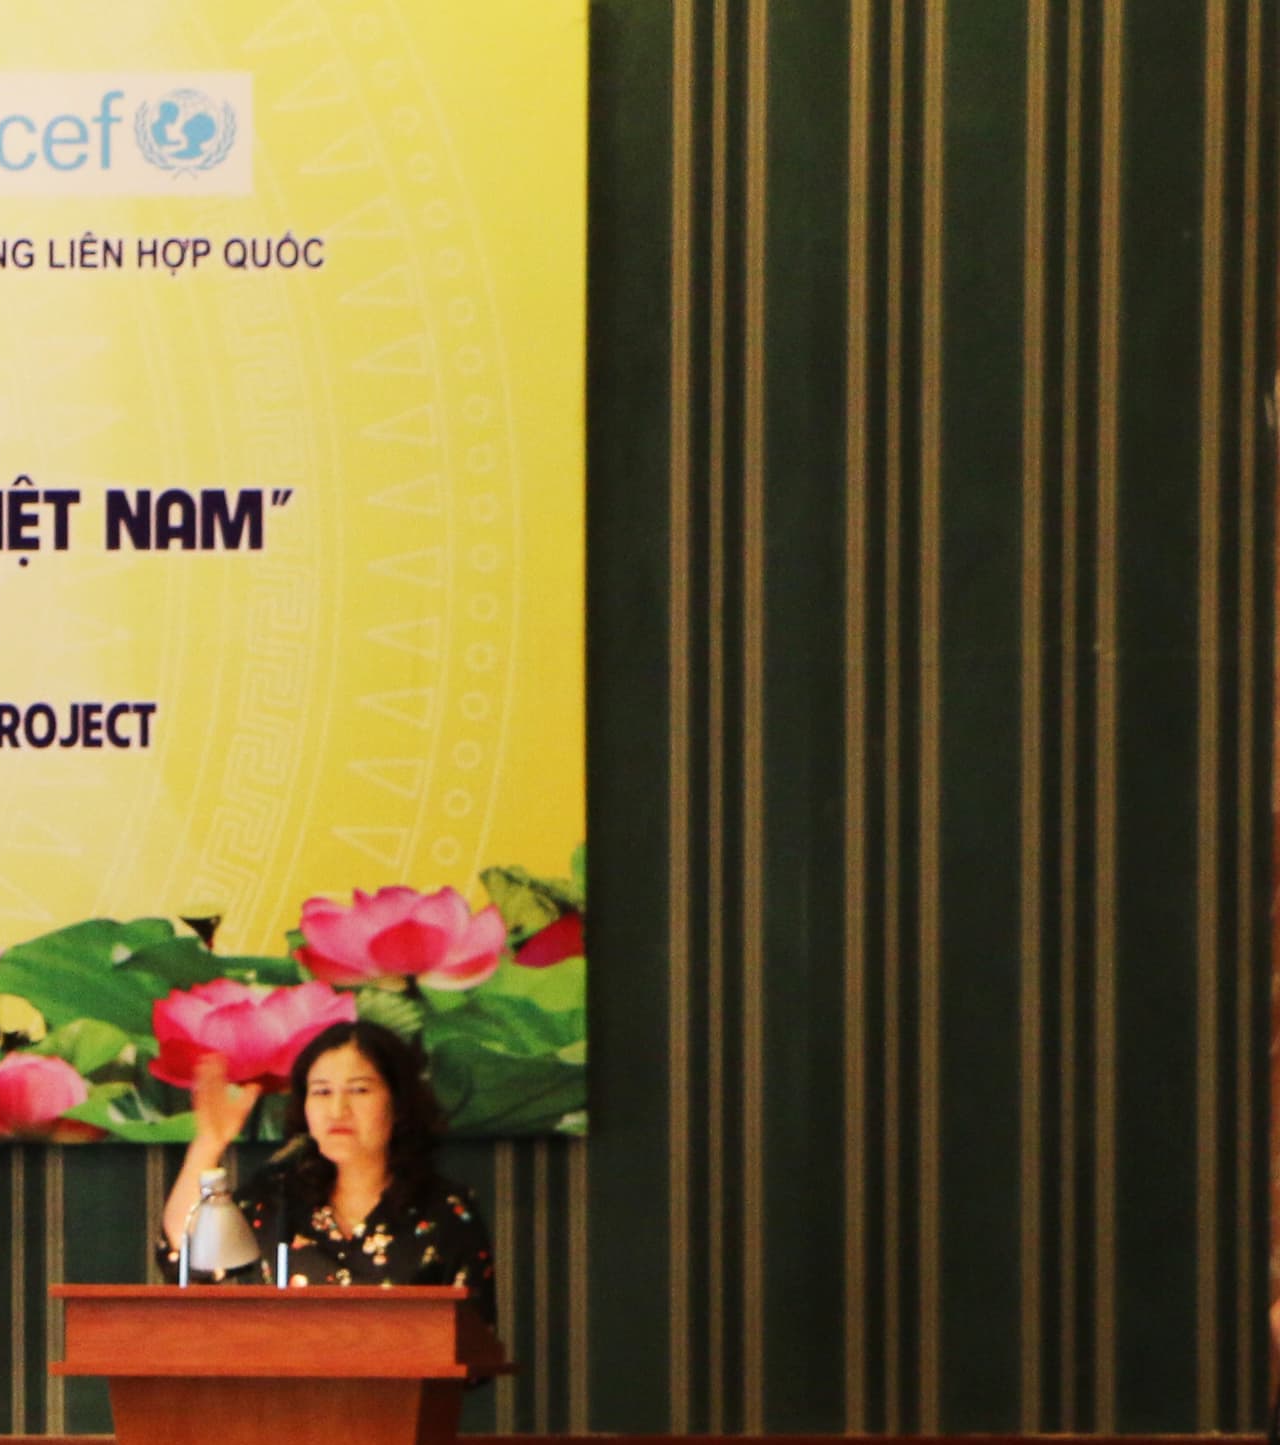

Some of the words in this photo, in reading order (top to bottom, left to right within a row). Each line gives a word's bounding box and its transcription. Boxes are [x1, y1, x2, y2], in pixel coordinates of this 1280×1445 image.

[47, 230, 124, 270] LIÊN
[136, 237, 213, 278] HỢP
[222, 228, 325, 271] QUỐC
